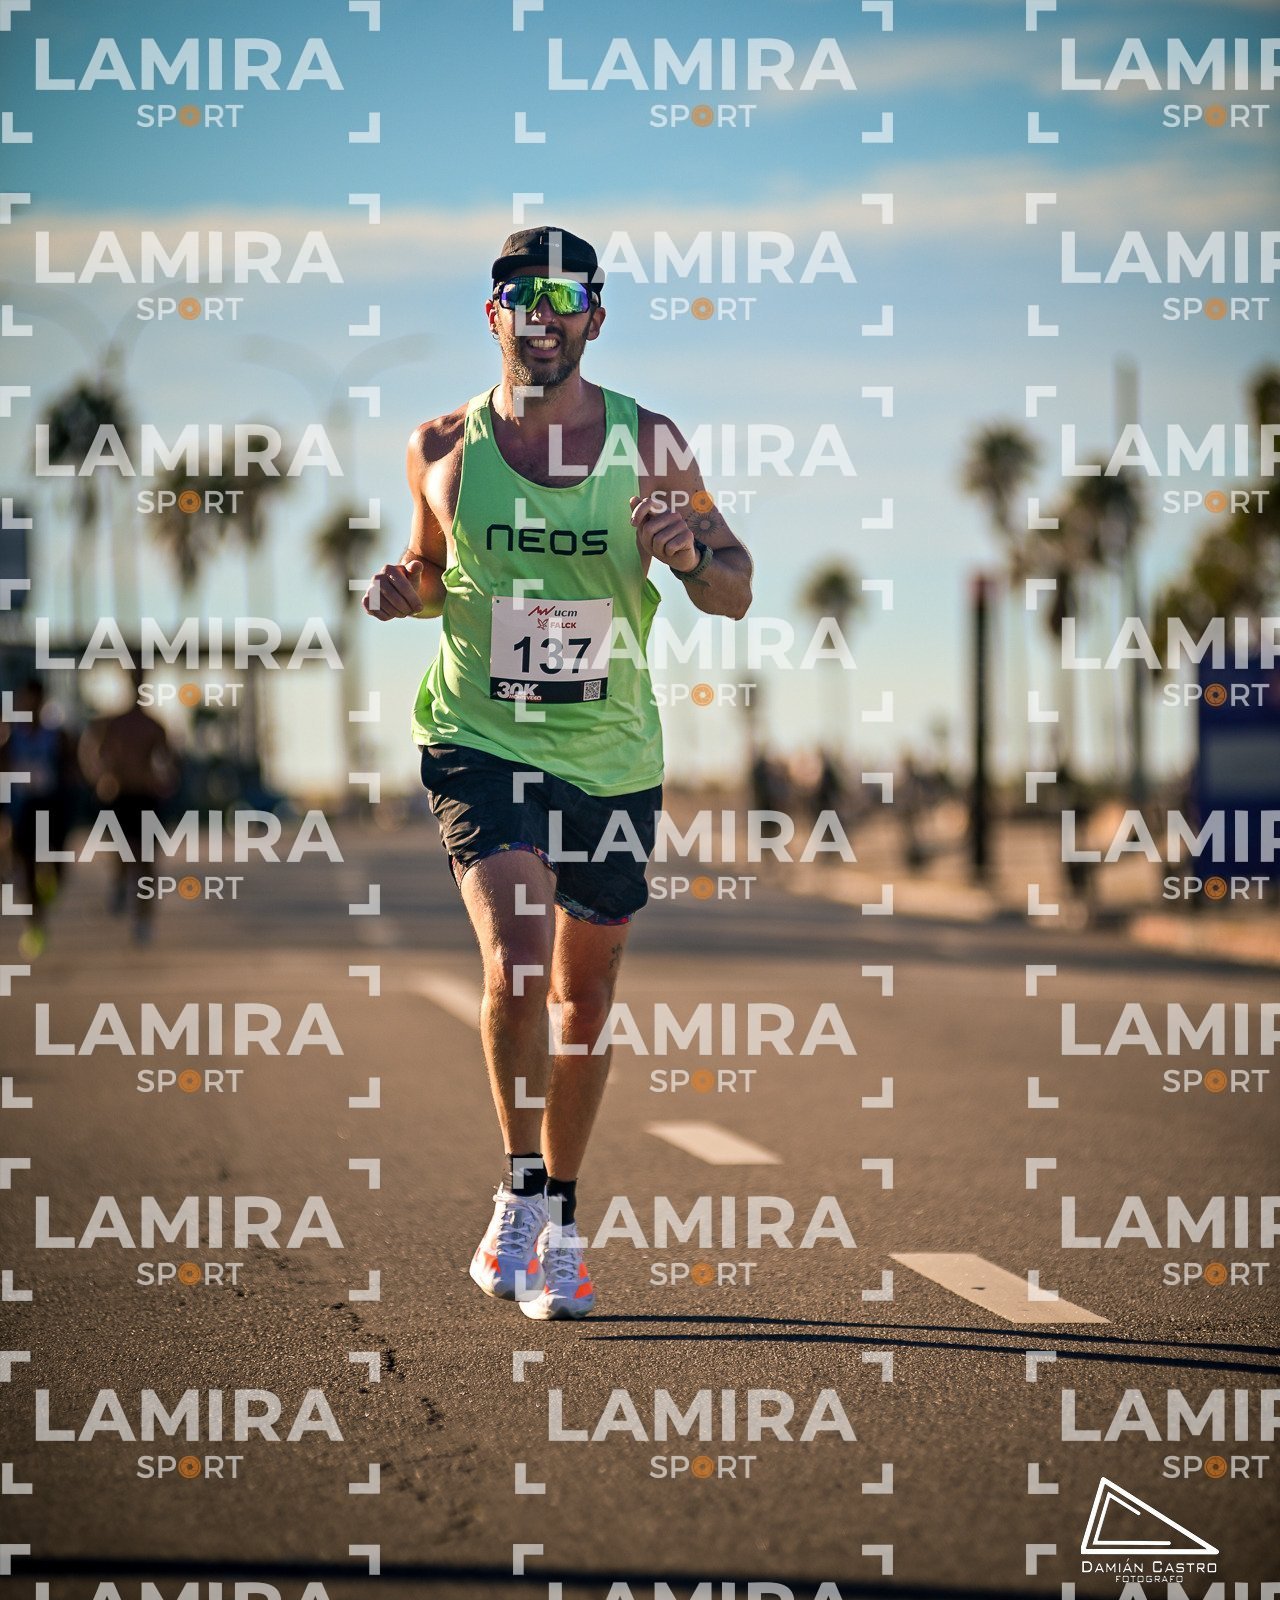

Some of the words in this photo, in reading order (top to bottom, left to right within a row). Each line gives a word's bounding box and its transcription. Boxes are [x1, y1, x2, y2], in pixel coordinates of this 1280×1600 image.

[486, 523, 608, 556] NEOS
[554, 609, 578, 617] ucm
[513, 636, 592, 675] 137
[496, 681, 539, 699] 30K
